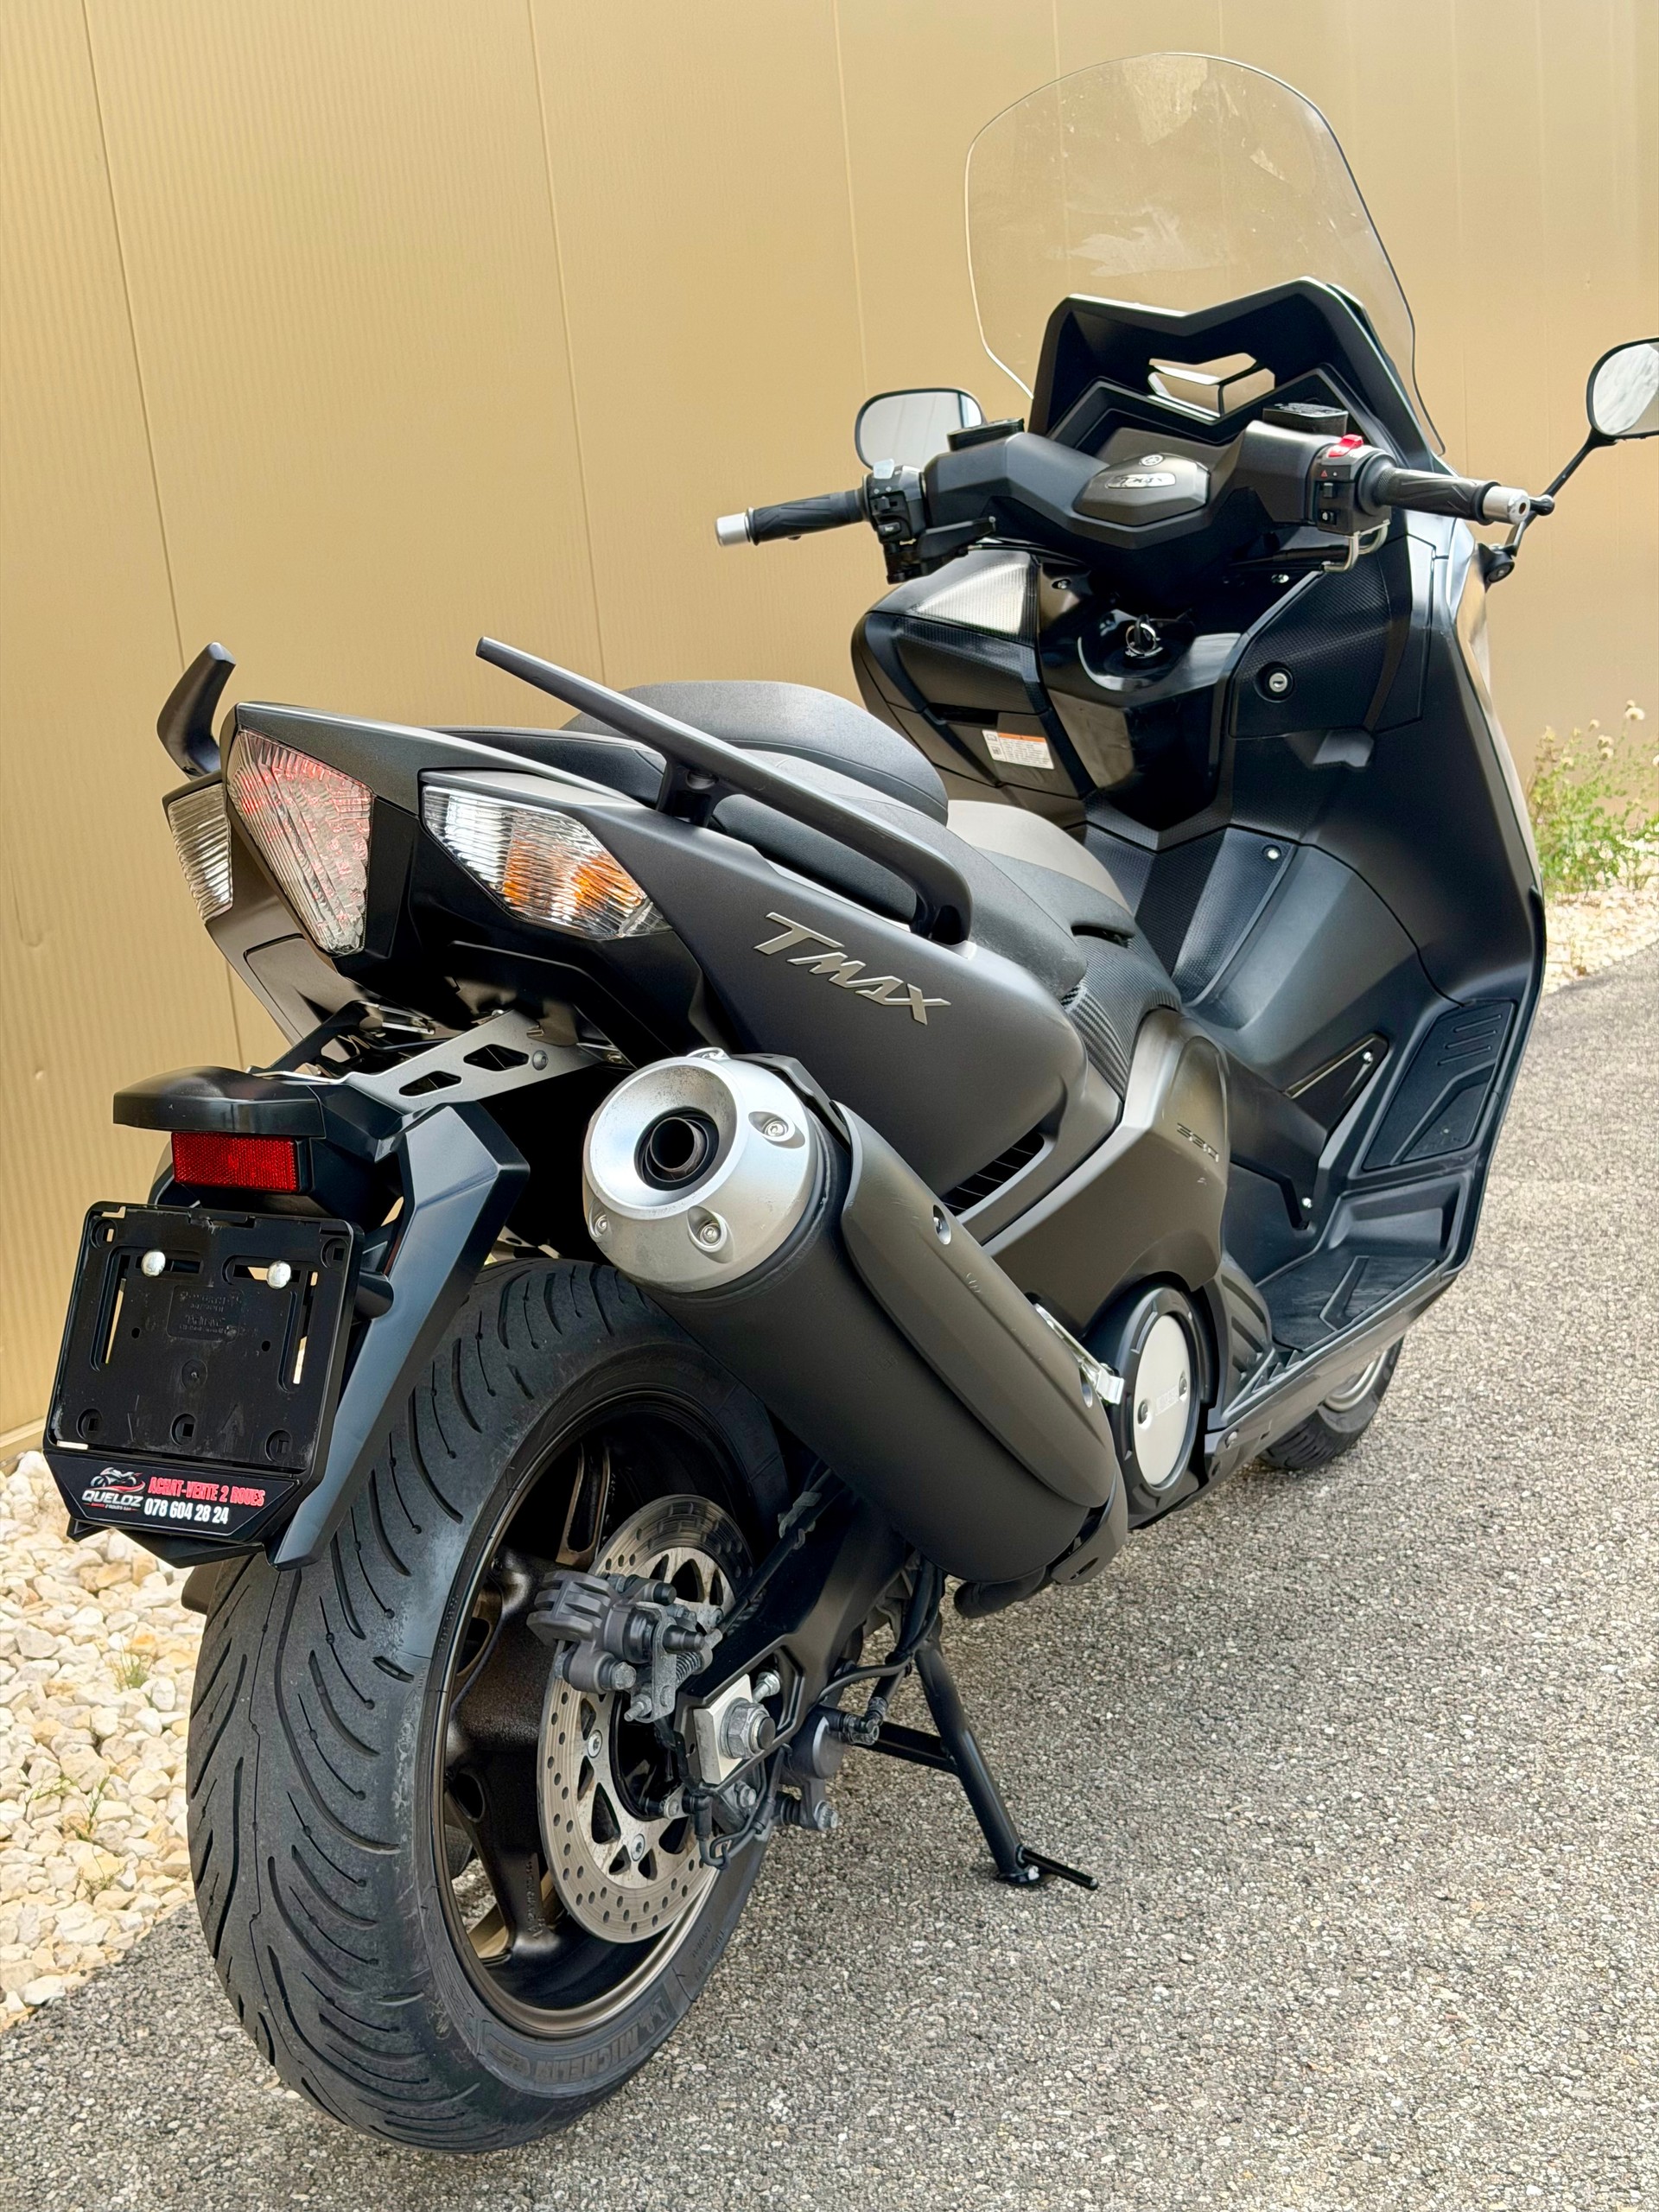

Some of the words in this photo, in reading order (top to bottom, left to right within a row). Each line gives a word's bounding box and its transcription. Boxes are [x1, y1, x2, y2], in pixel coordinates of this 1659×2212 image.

[753, 911, 952, 1026] TMAX
[1177, 1122, 1219, 1163] 530
[81, 1490, 144, 1507] QUELOZ
[148, 1477, 219, 1501] ACHAT-VENTE
[220, 1485, 230, 1503] 2
[230, 1486, 266, 1507] ROUES
[143, 1498, 168, 1517] 078
[169, 1501, 193, 1521] 604
[194, 1503, 210, 1522] 28
[212, 1506, 230, 1525] 24
[534, 2024, 640, 2083] MICHELIN
